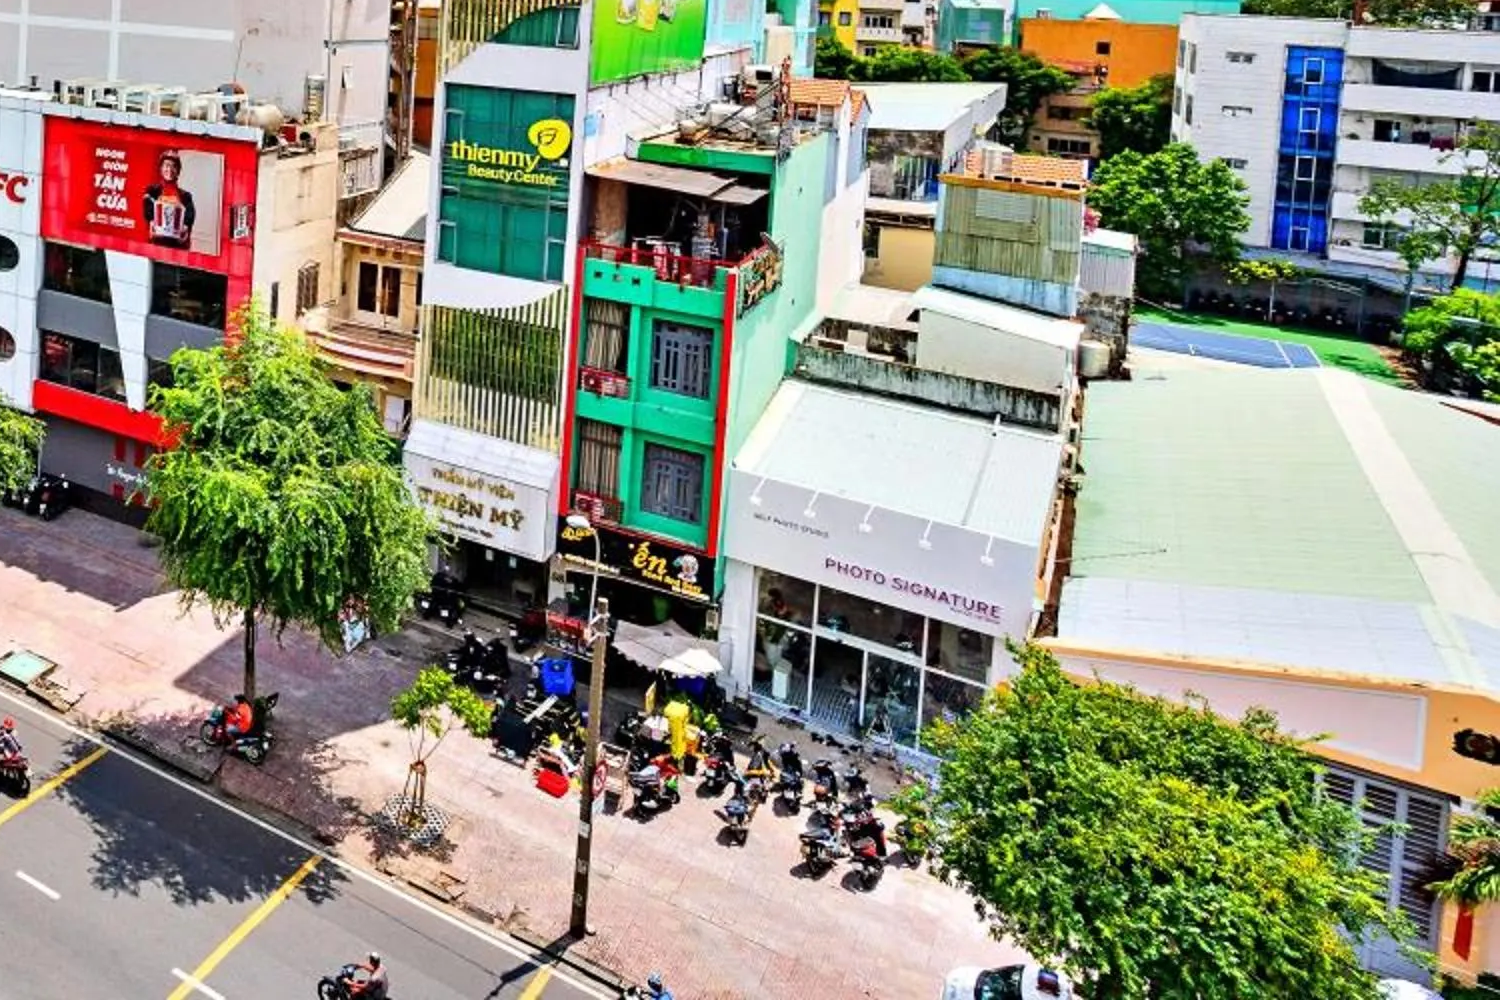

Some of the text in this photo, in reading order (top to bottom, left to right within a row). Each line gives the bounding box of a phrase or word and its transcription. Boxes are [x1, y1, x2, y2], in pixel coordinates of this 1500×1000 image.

[451, 139, 540, 173] thienmy
[467, 163, 558, 186] Beauty Center
[824, 557, 887, 585] PHOTO
[891, 576, 1005, 620] SIGNATURE
